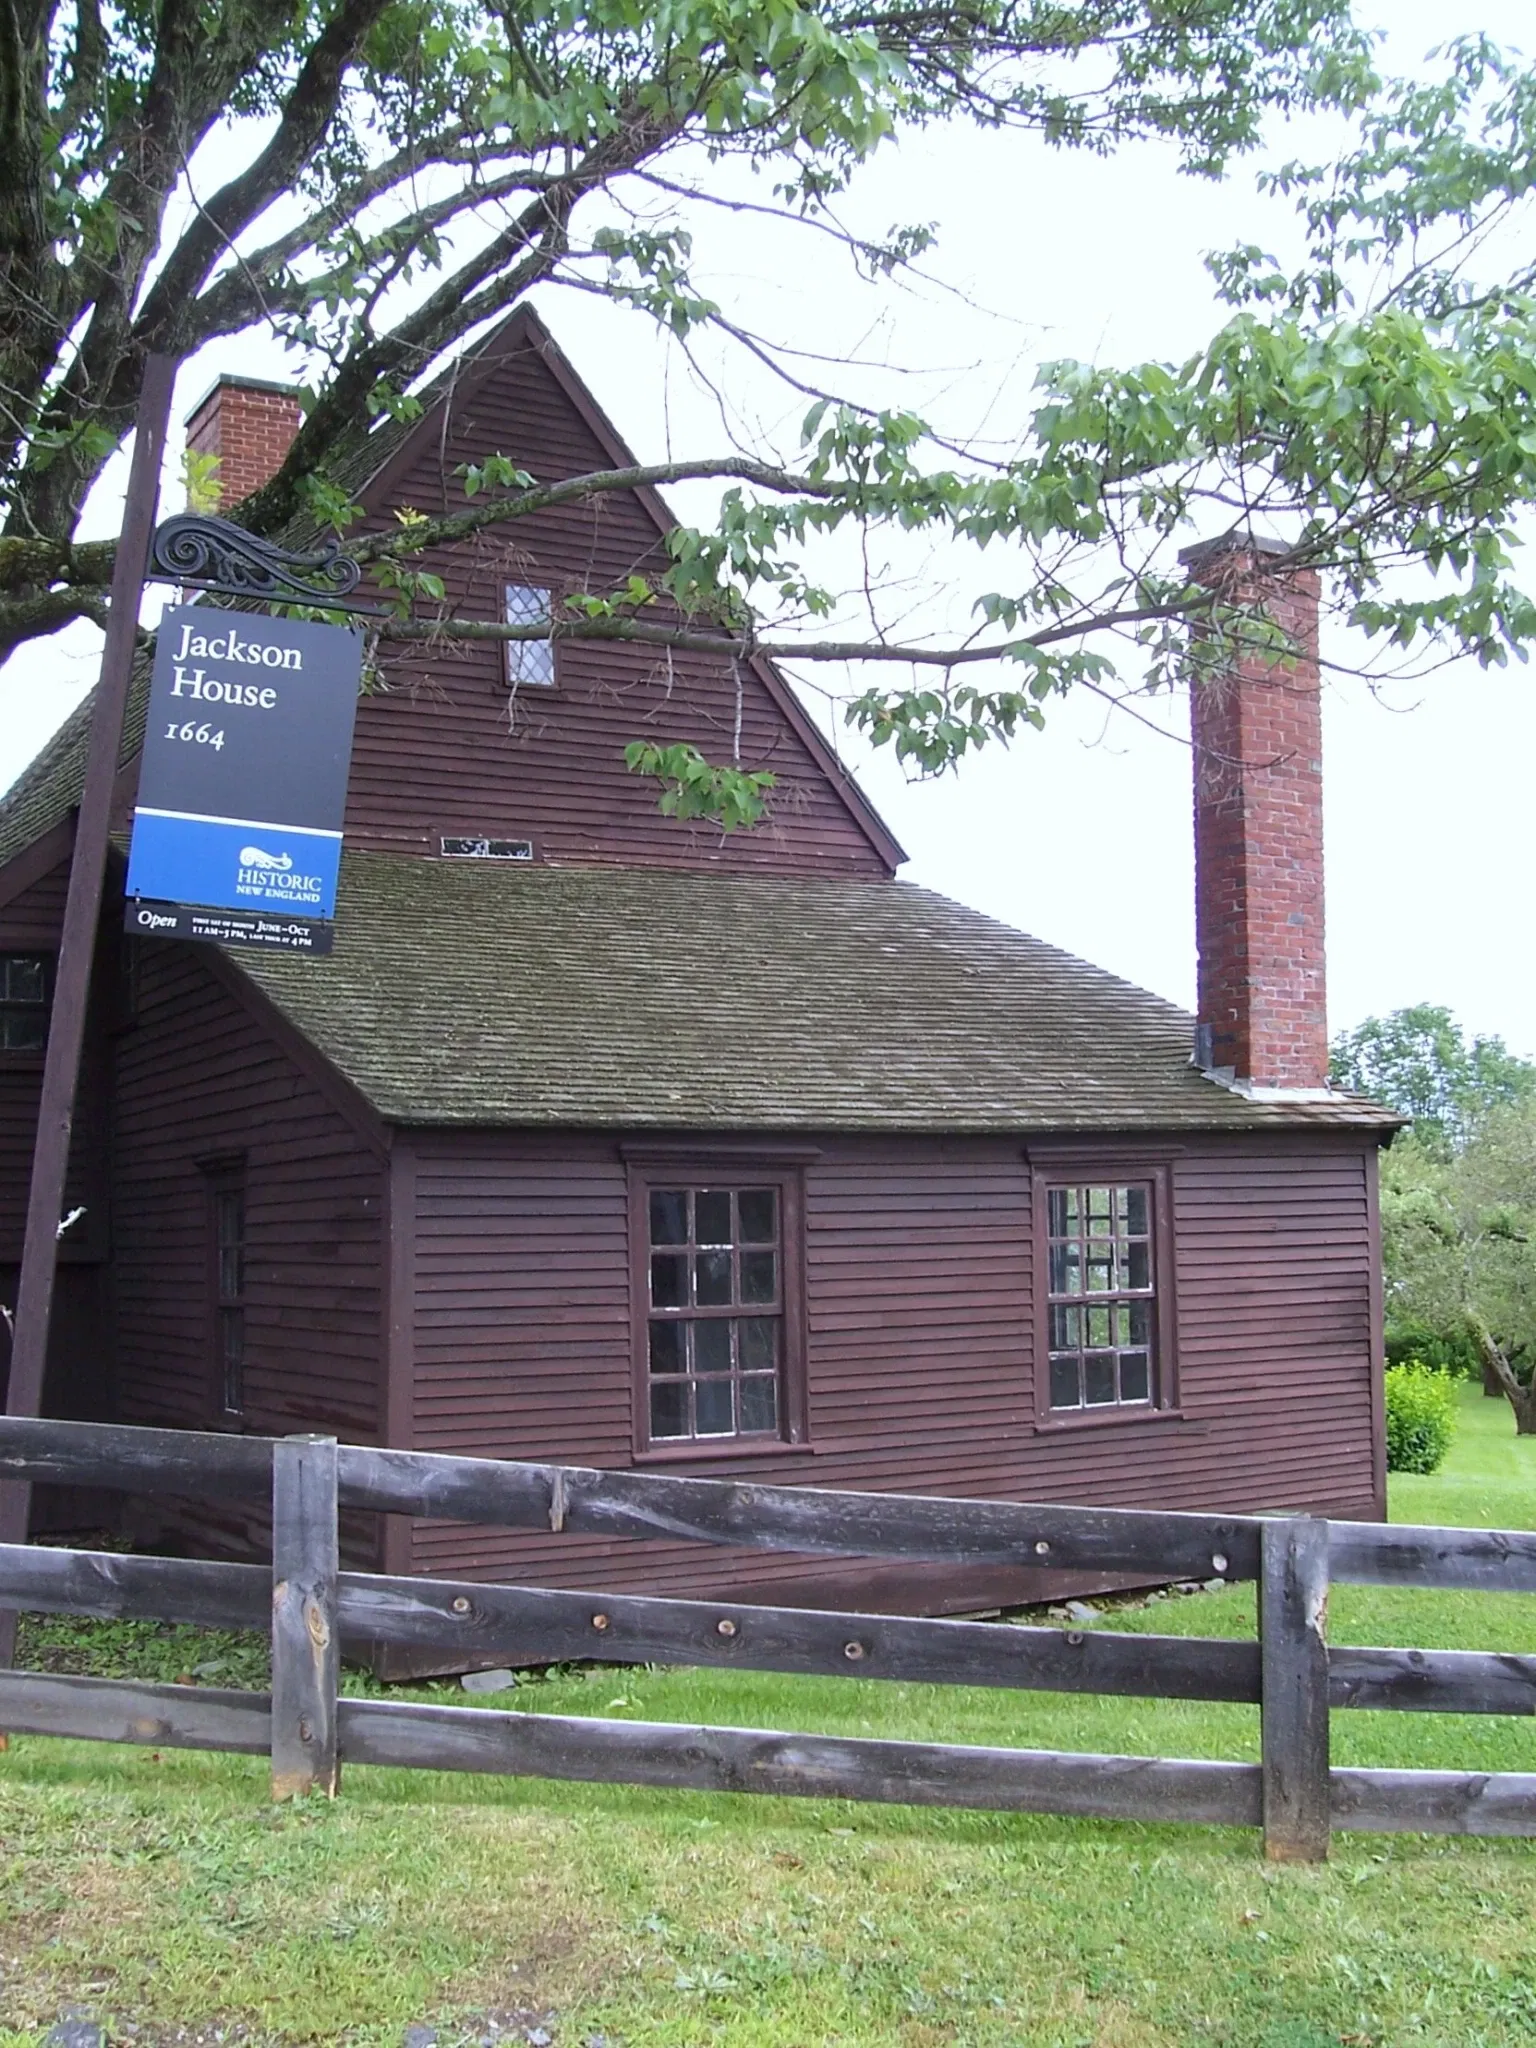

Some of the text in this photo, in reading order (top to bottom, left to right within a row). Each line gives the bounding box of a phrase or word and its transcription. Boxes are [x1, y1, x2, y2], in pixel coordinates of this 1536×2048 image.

[172, 624, 303, 670] Jackson
[170, 666, 278, 709] House
[164, 721, 225, 752] 1664
[237, 868, 322, 891] HISTORIC
[236, 885, 320, 902] NEW ENGLAND
[137, 911, 177, 928] Open
[291, 937, 298, 946] 4
[298, 937, 312, 946] PM
